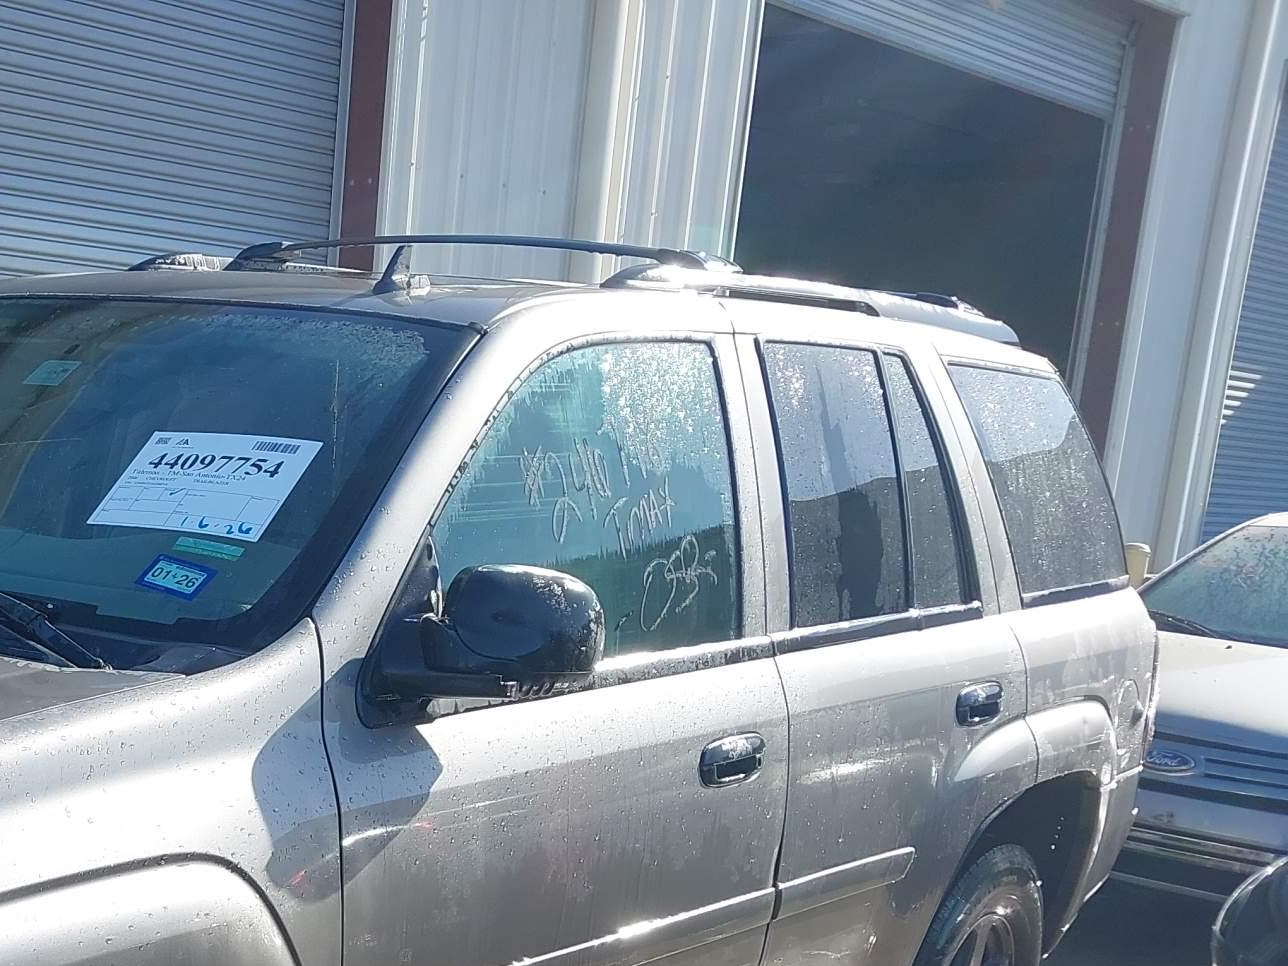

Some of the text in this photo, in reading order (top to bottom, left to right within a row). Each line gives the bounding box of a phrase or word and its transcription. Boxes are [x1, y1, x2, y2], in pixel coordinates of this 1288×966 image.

[148, 452, 285, 478] 44097754
[151, 566, 173, 581] 01
[174, 573, 200, 589] 26
[1146, 751, 1183, 767] Ford
